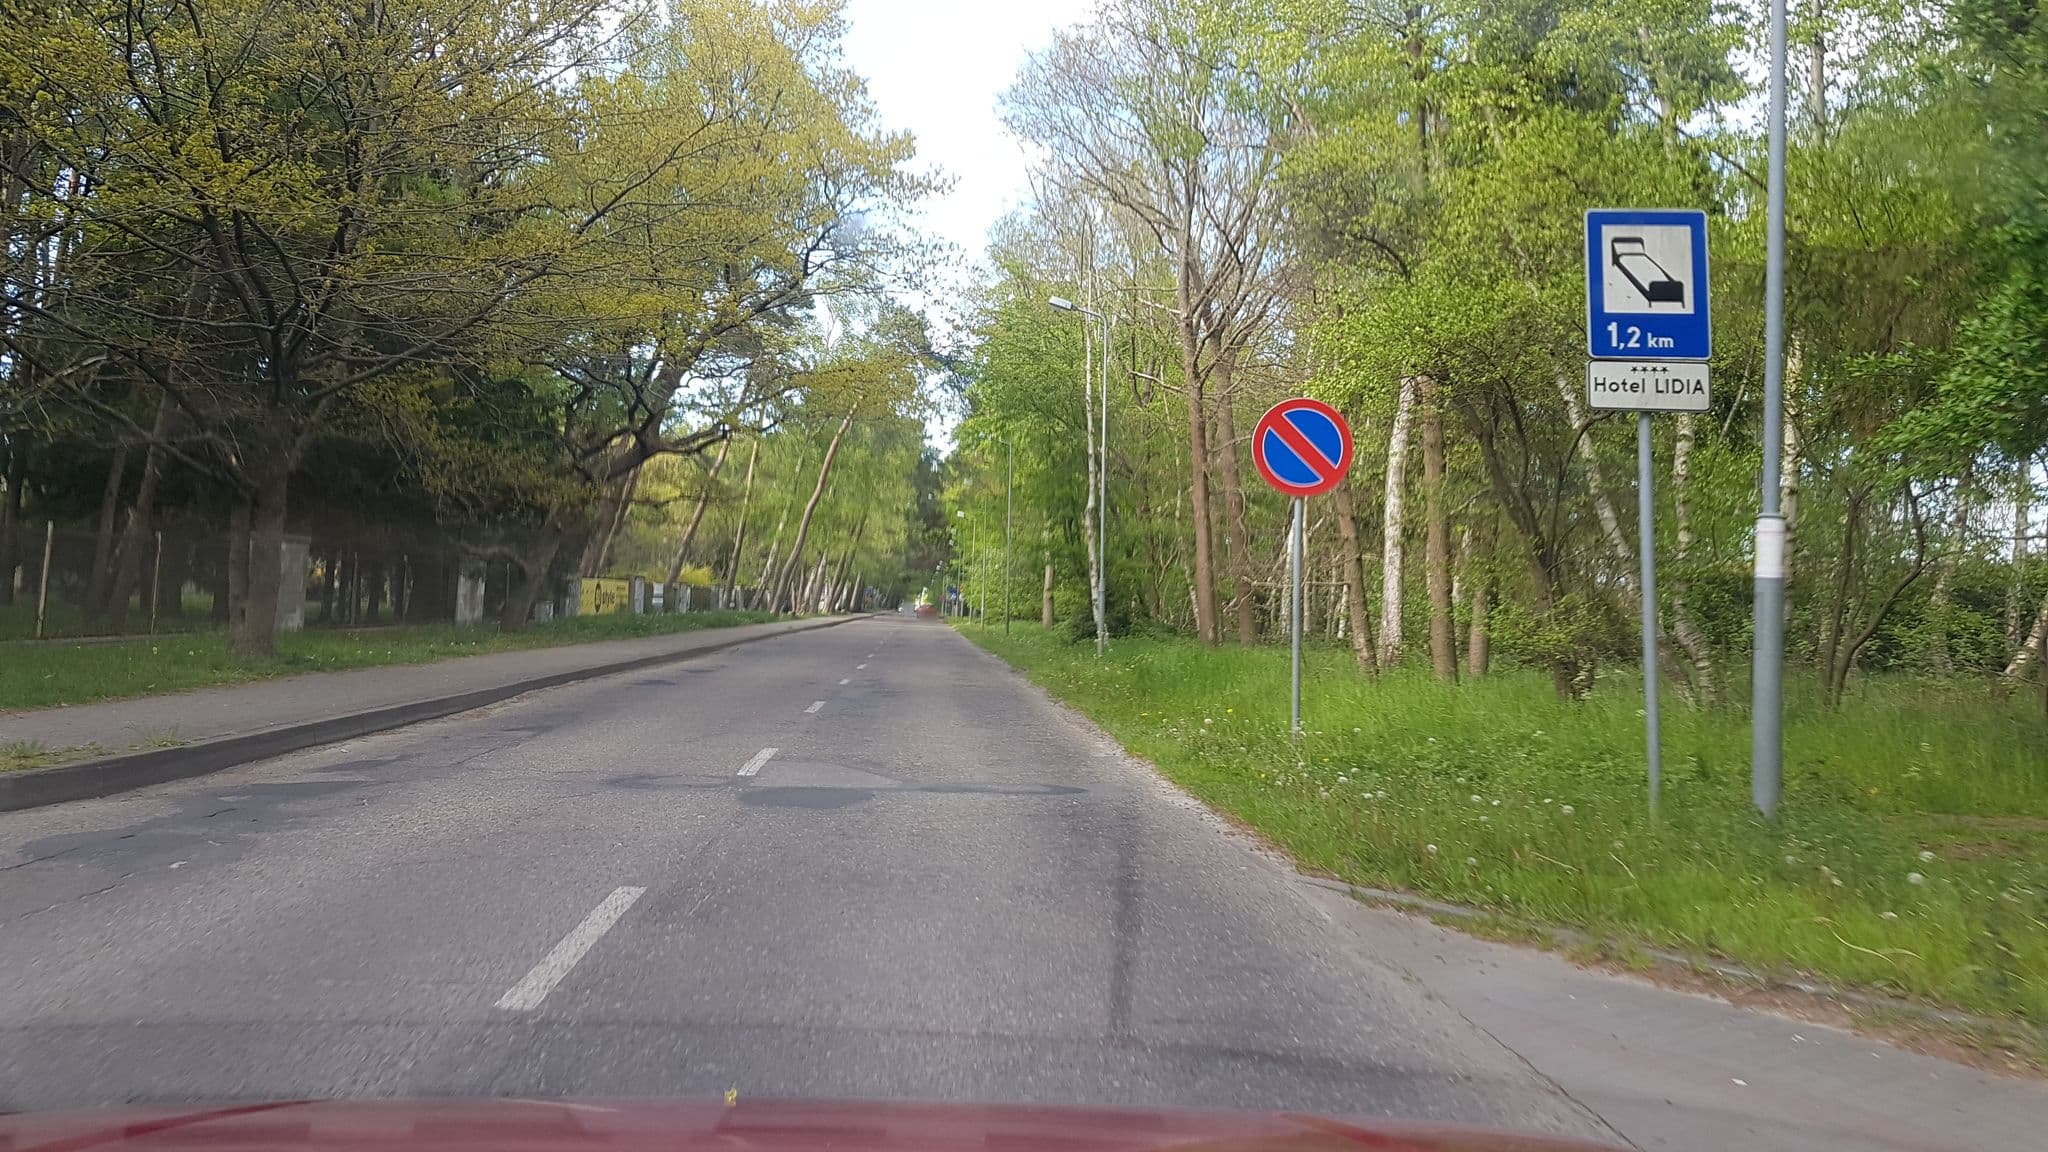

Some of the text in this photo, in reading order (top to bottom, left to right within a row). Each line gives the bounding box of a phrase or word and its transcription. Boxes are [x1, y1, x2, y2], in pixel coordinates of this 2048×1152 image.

[1607, 321, 1674, 350] 1,2 km
[1594, 377, 1705, 394] Hotel LIDIA
